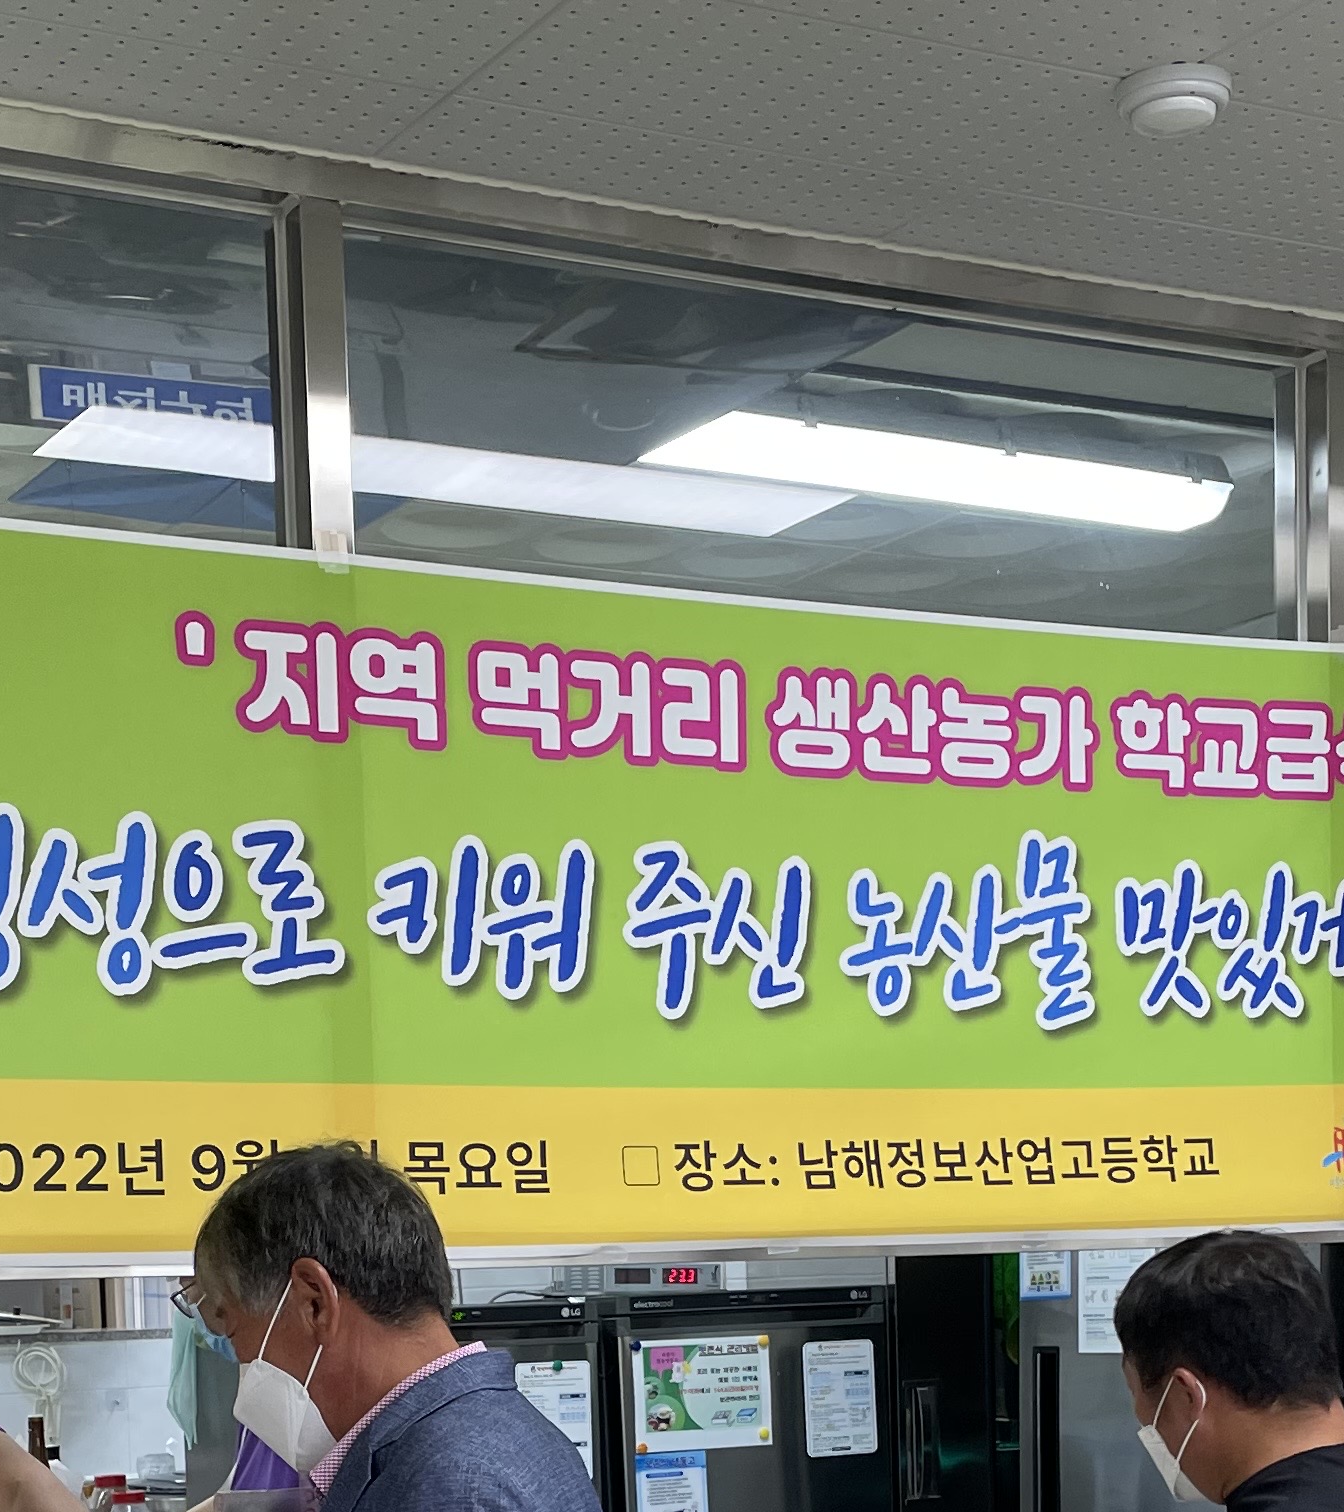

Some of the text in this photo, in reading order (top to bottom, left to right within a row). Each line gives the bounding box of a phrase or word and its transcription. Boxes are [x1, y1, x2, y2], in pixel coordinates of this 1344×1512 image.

[234, 620, 445, 750] 지역
[468, 640, 748, 771] 먹거리
[765, 666, 1098, 792] 생산농가
[368, 834, 597, 1001] 키워
[624, 841, 811, 1021] 주신
[839, 829, 1095, 1030] 농산물
[404, 1139, 551, 1195] 목요일
[673, 1134, 1220, 1191] 장소: 남해정보산업고등학교
